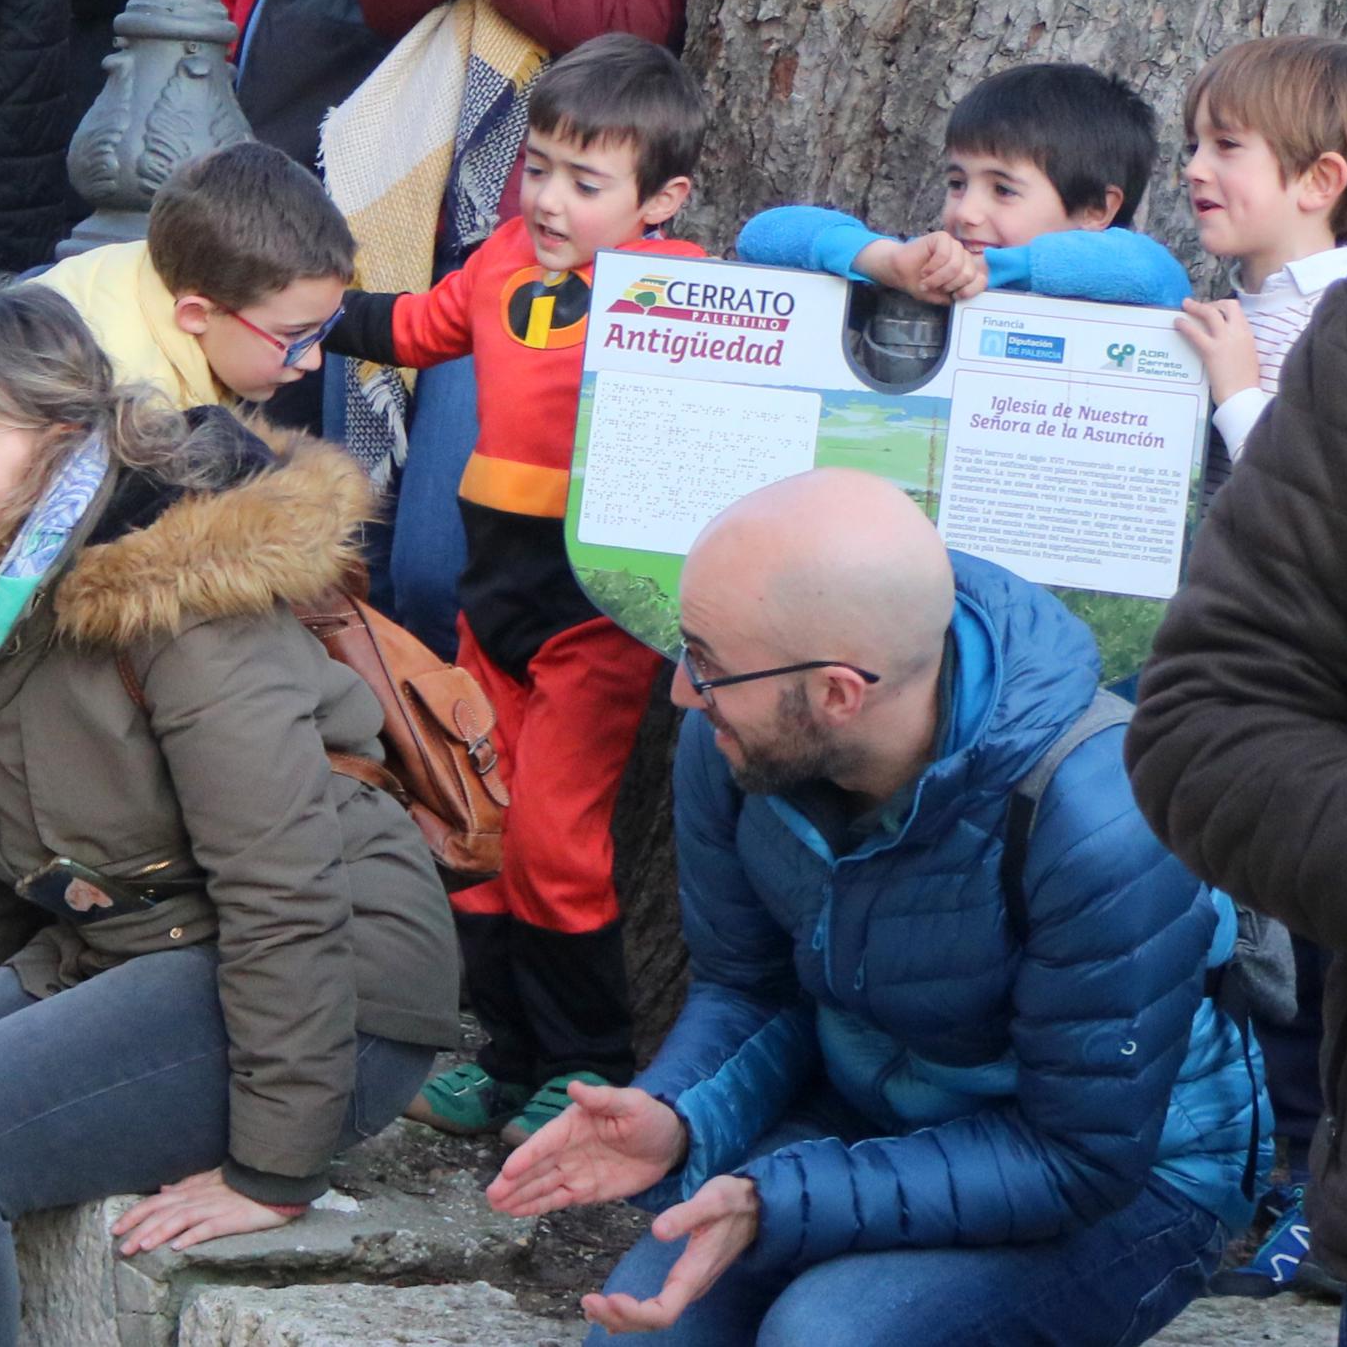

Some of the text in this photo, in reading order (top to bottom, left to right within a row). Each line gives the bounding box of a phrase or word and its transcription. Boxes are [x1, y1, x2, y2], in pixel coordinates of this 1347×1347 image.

[666, 281, 795, 316] CERRATO
[692, 312, 780, 329] PALENTINO
[982, 316, 1025, 329] Financia
[603, 323, 785, 366] Antigüedad
[1009, 336, 1053, 348] Diputación
[1007, 347, 1062, 359] DE PALENCIA
[1139, 349, 1169, 359] ADRI
[1138, 358, 1182, 369] Cerrato
[1137, 366, 1189, 379] Palentino
[991, 396, 1149, 426] Iglesia de Nuestra
[970, 413, 1165, 449] Señora de la Asunción
